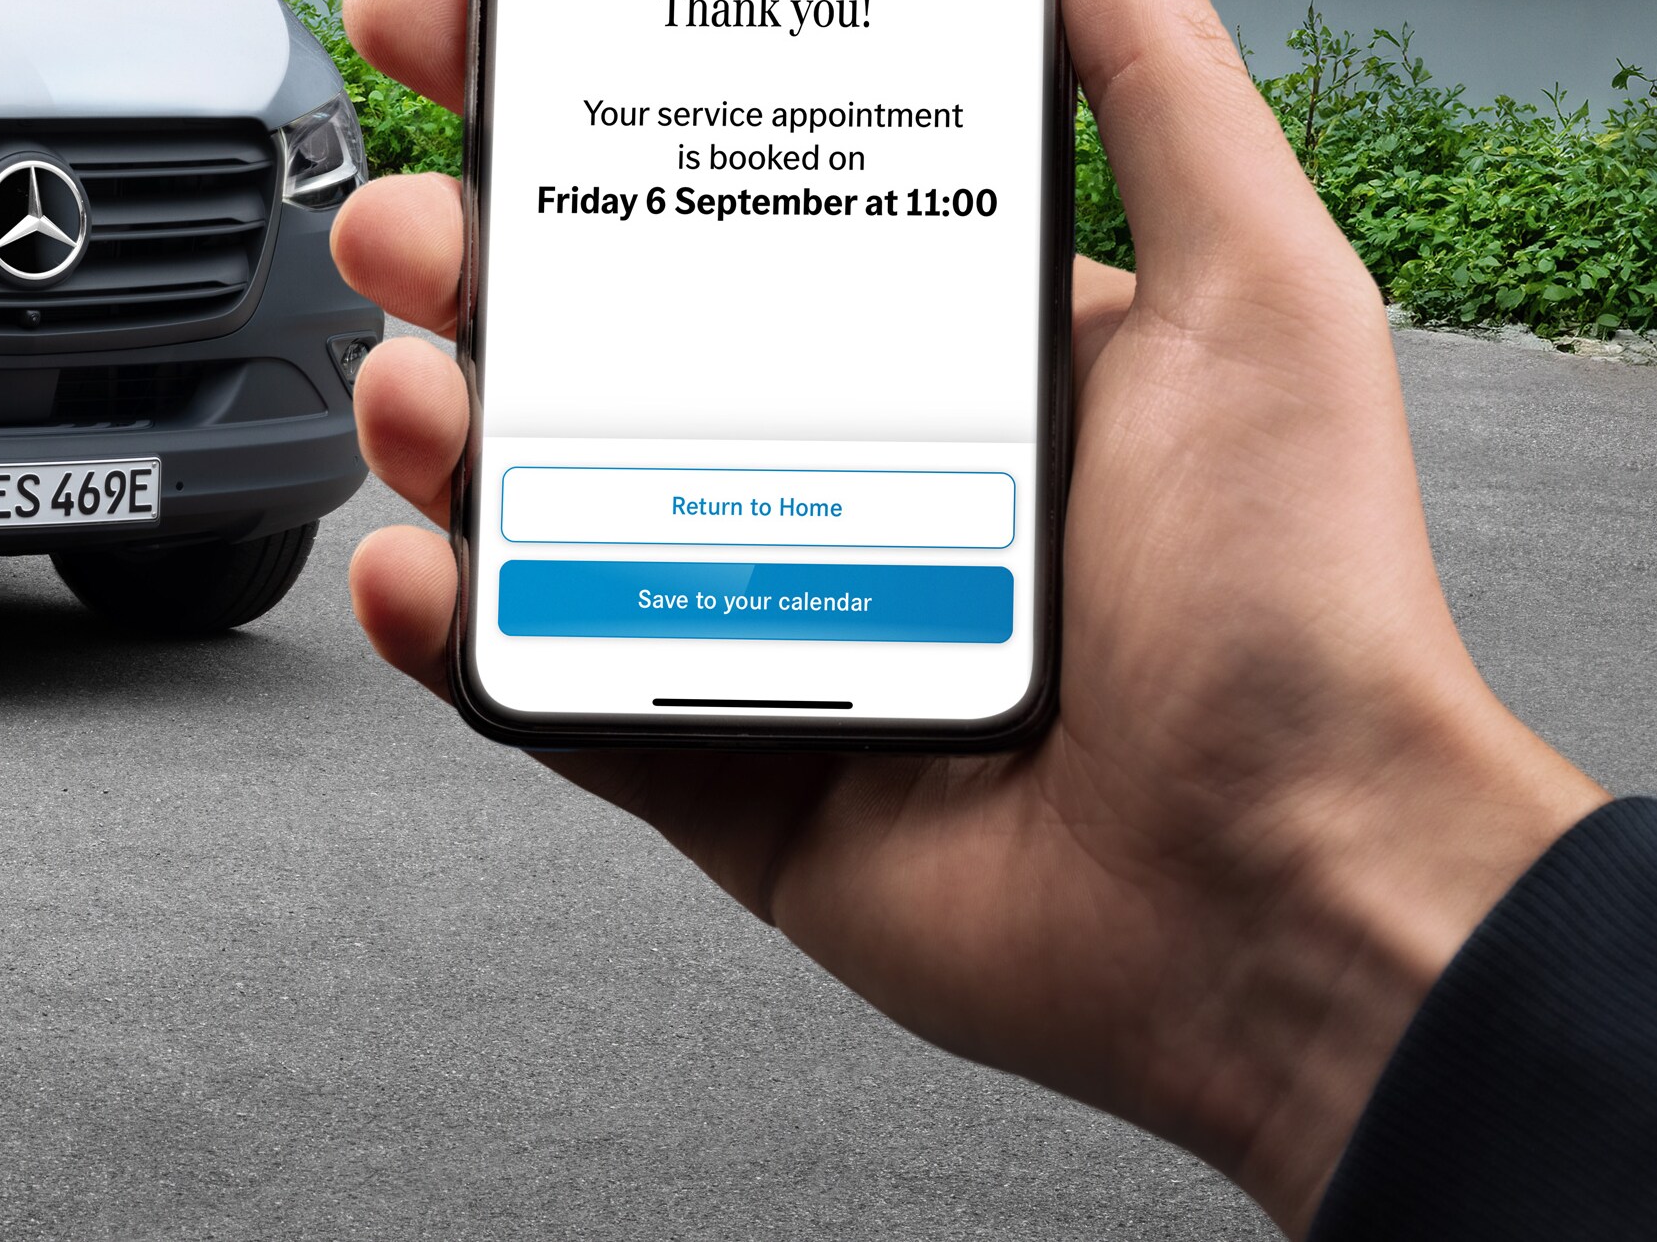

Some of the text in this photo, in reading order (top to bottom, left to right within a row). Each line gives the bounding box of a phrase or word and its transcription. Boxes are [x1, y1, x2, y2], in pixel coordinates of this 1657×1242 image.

[583, 99, 964, 134] Your service appointment
[678, 143, 865, 171] is booked on
[538, 185, 998, 222] Friday 6 September at 11:00
[672, 496, 843, 518] Return to Home
[638, 589, 873, 615] Save to your calendar
